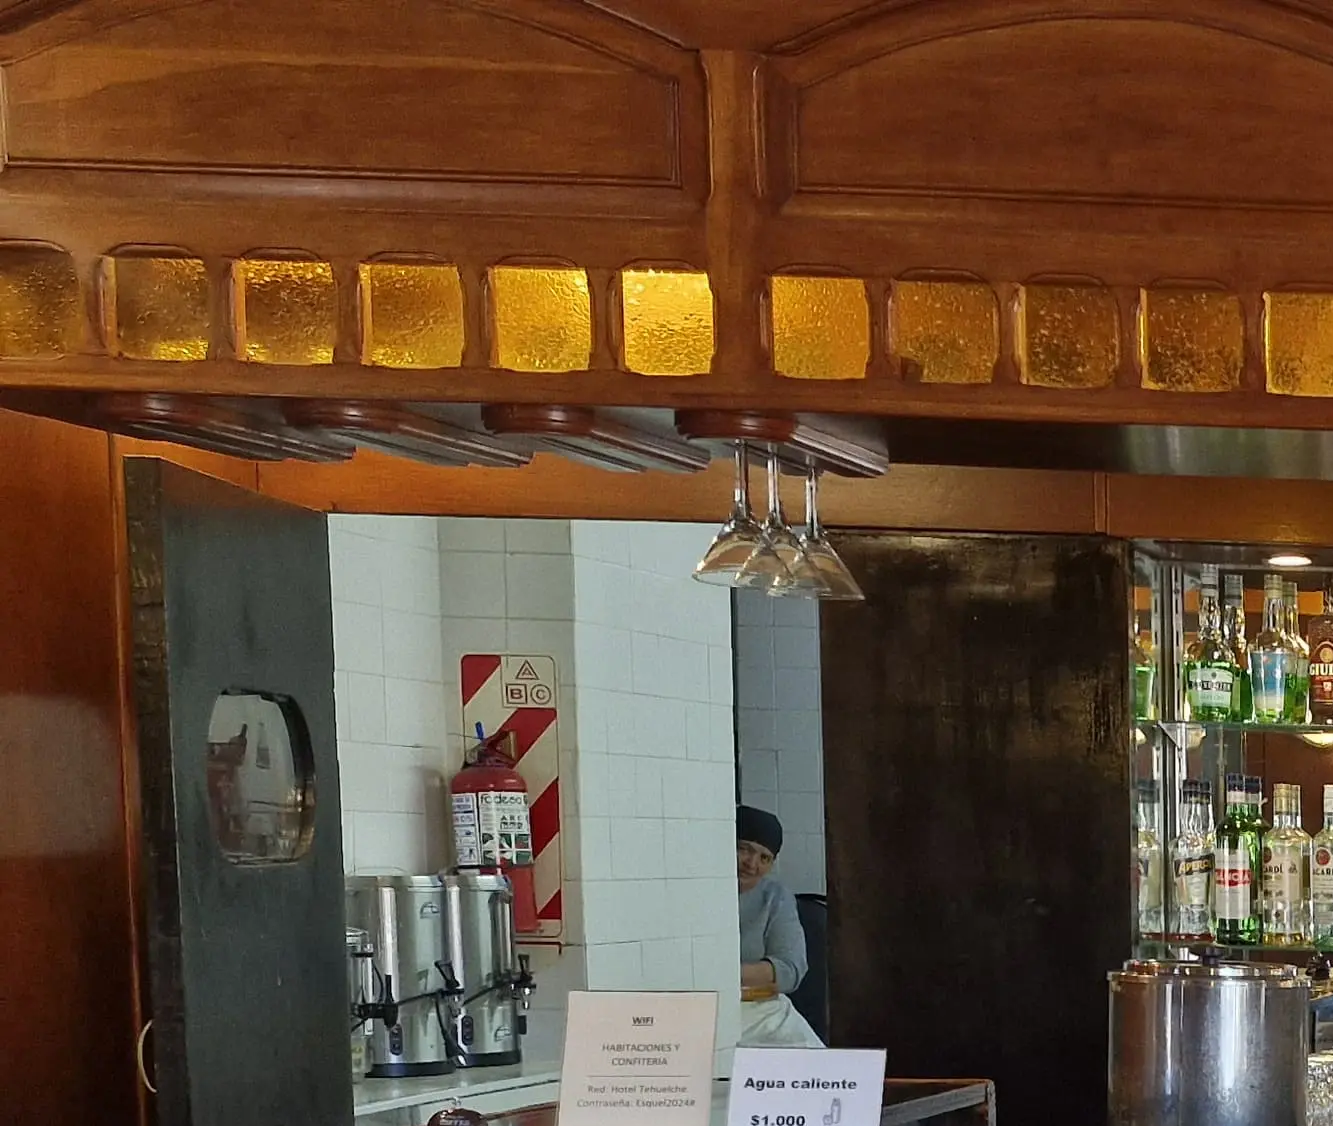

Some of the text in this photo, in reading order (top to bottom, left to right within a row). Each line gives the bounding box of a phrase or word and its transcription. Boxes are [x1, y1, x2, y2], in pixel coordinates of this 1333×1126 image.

[510, 688, 546, 700] B C
[632, 1016, 654, 1026] WIFI
[602, 1043, 681, 1052] HABITACIONES Y
[587, 1085, 687, 1094] Red: Hotel Tehuelche
[744, 1077, 857, 1091] Agua caliente
[751, 1114, 806, 1126] $1.000
